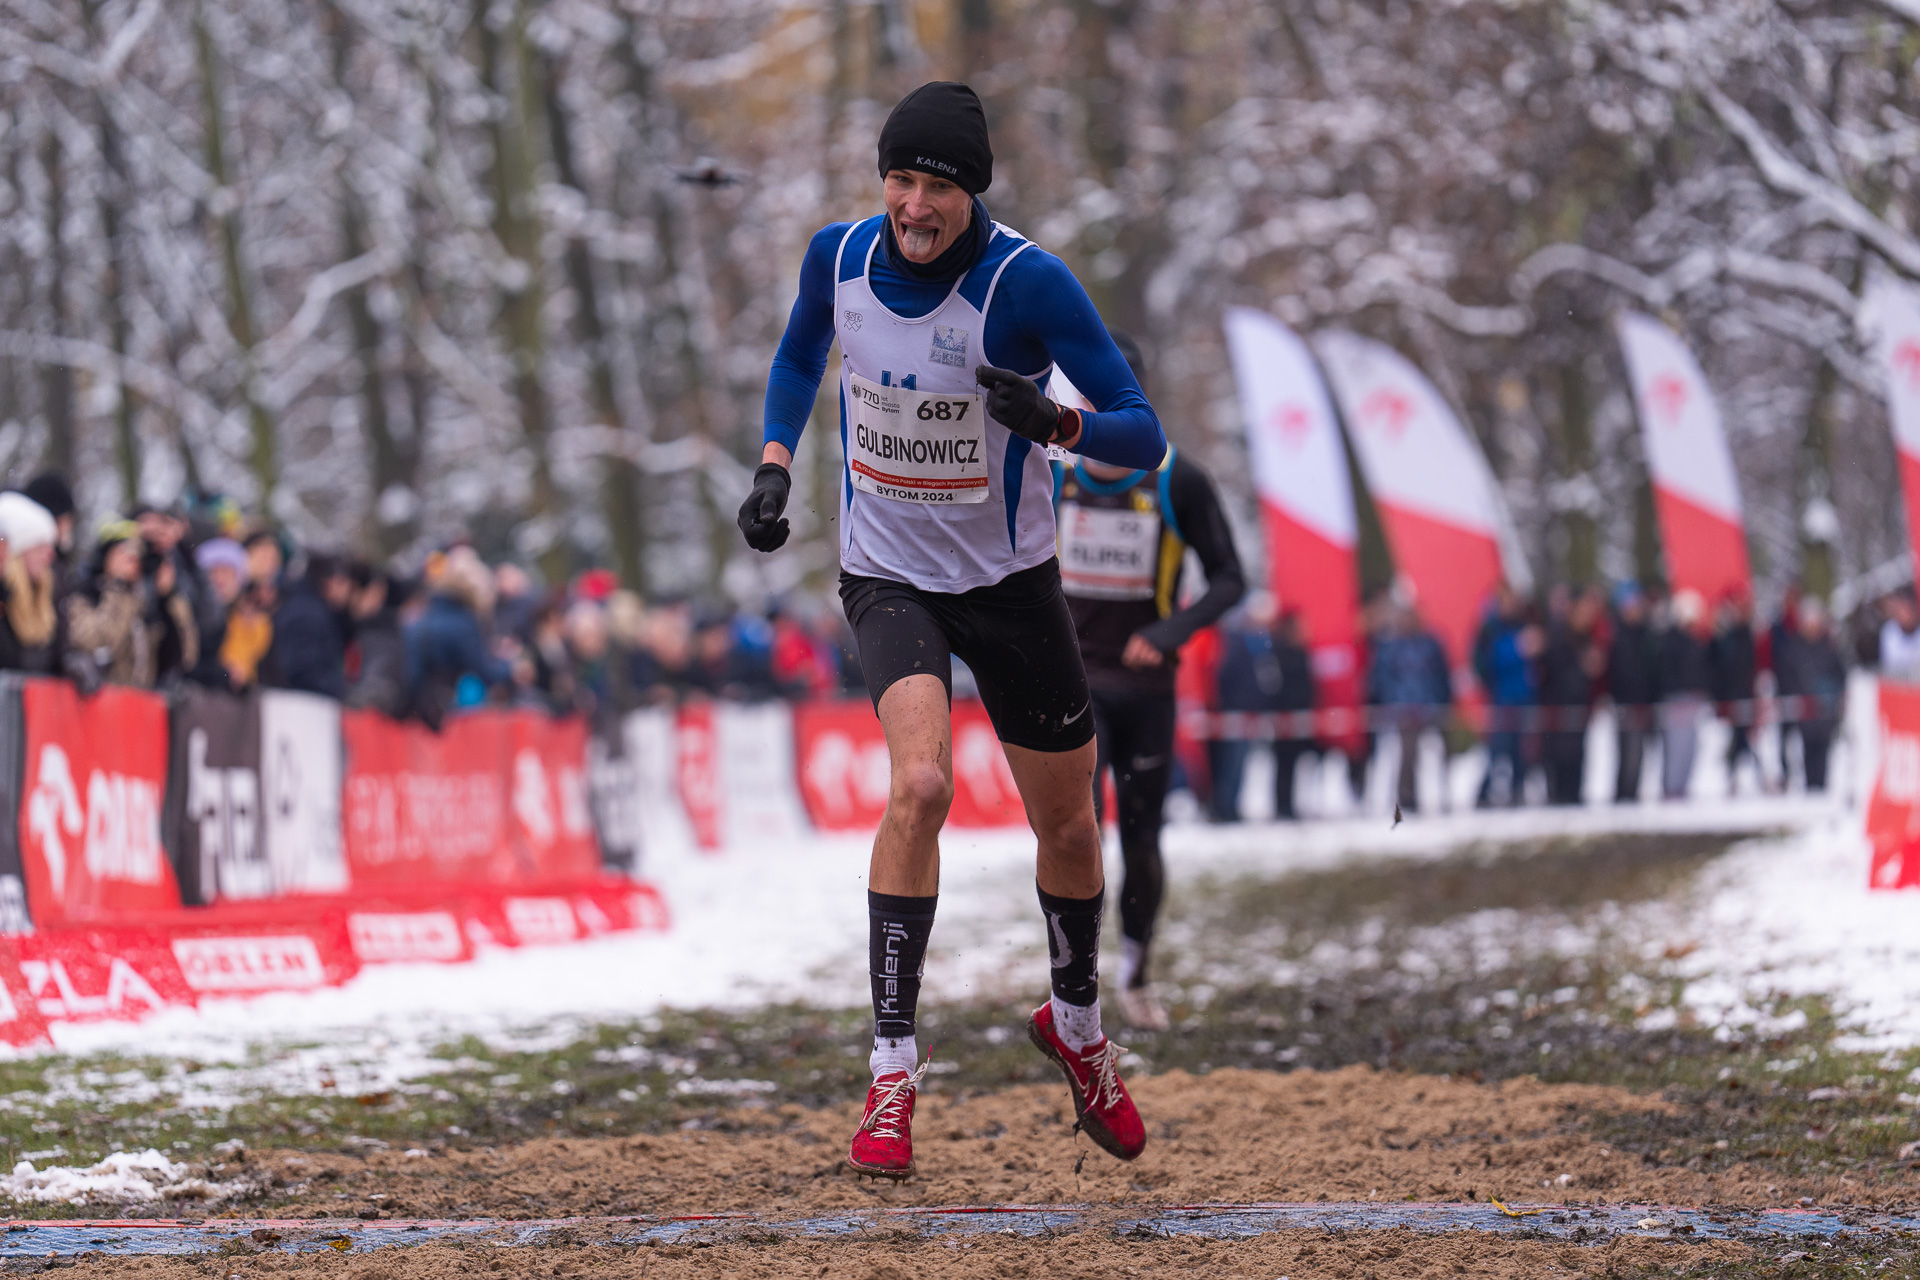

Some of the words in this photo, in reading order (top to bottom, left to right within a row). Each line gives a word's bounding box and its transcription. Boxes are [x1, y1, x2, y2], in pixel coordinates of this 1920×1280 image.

[916, 156, 958, 175] KALENJI
[862, 387, 880, 405] 770
[916, 400, 970, 421] 687
[857, 423, 979, 464] GULBINOWICZ
[922, 479, 947, 487] Biegach
[876, 484, 919, 500] BYTOM
[921, 491, 954, 501] 2024
